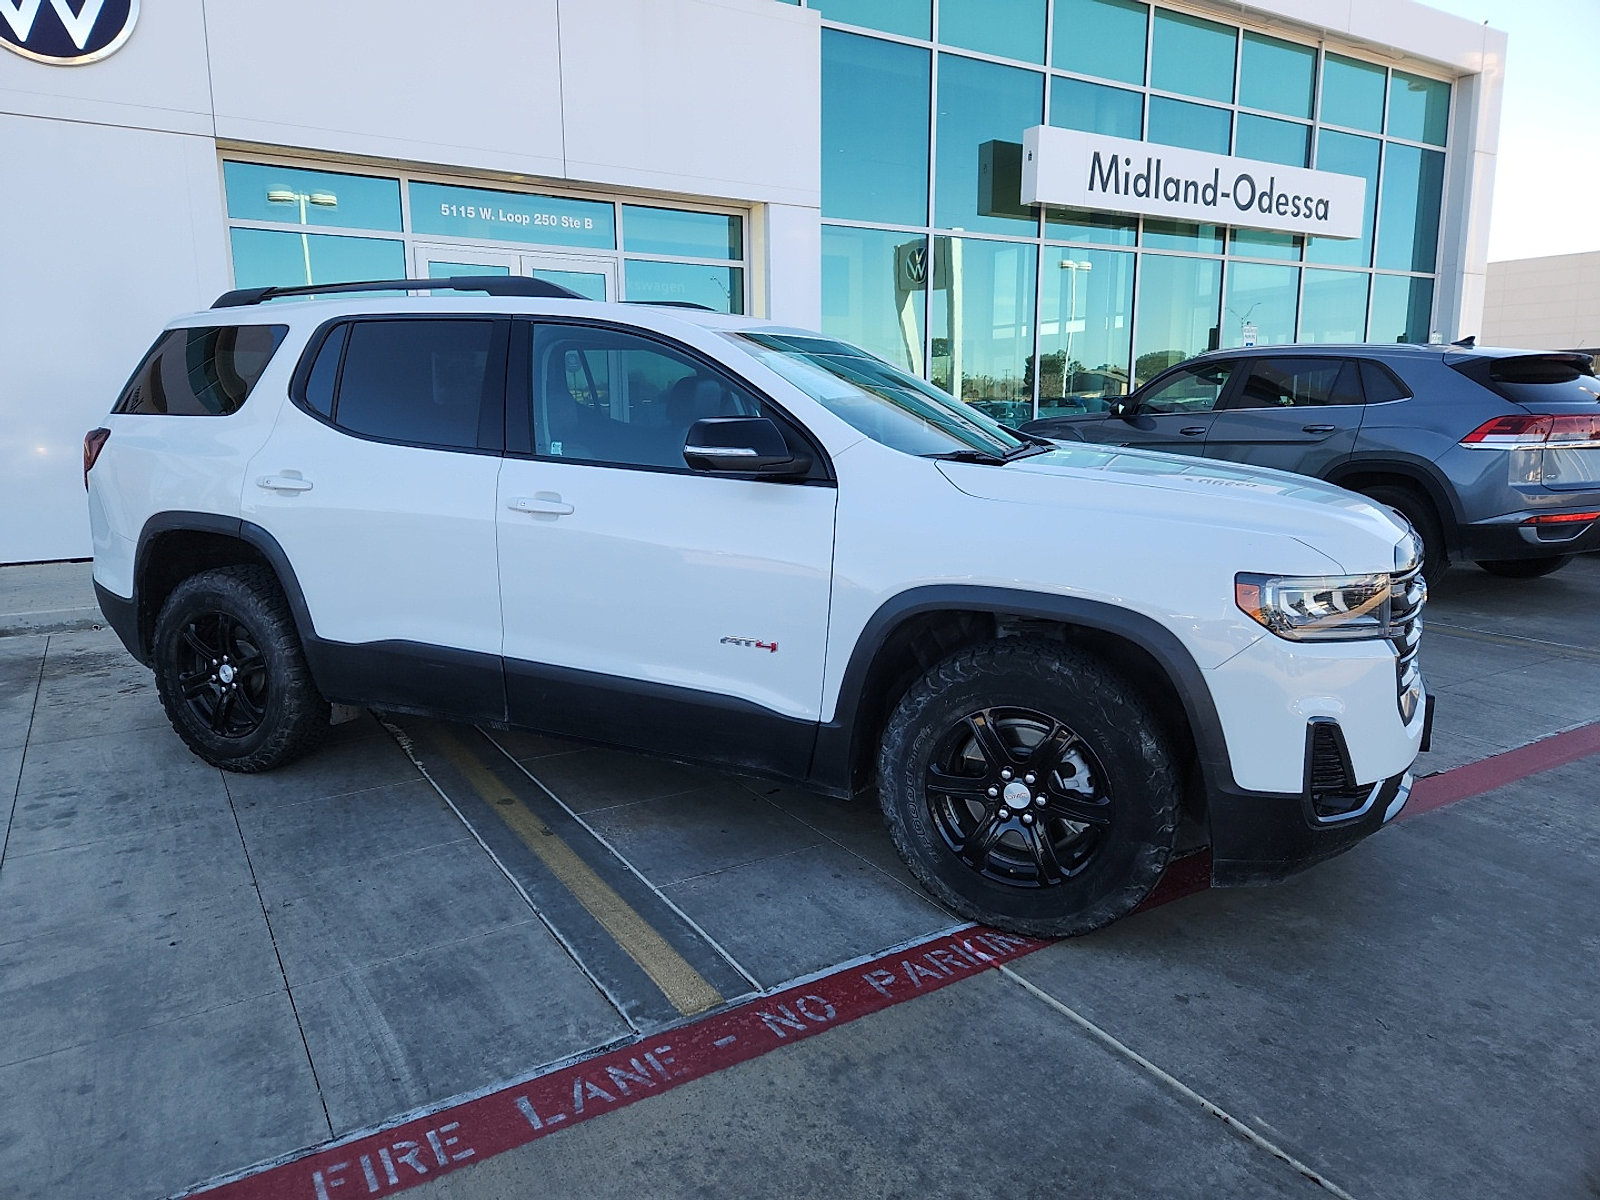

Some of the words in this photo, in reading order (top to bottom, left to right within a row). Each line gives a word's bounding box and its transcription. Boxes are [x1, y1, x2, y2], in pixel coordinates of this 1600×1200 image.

[440, 203, 476, 219] 5115
[478, 207, 496, 221] W.
[498, 209, 531, 226] Loop
[533, 213, 558, 227] 250
[560, 215, 582, 229] Ste
[584, 217, 594, 230] B
[1087, 150, 1330, 222] Midland-Odessa
[312, 1121, 476, 1200] FIRE
[515, 1045, 690, 1131] LANE
[756, 994, 836, 1039] NO
